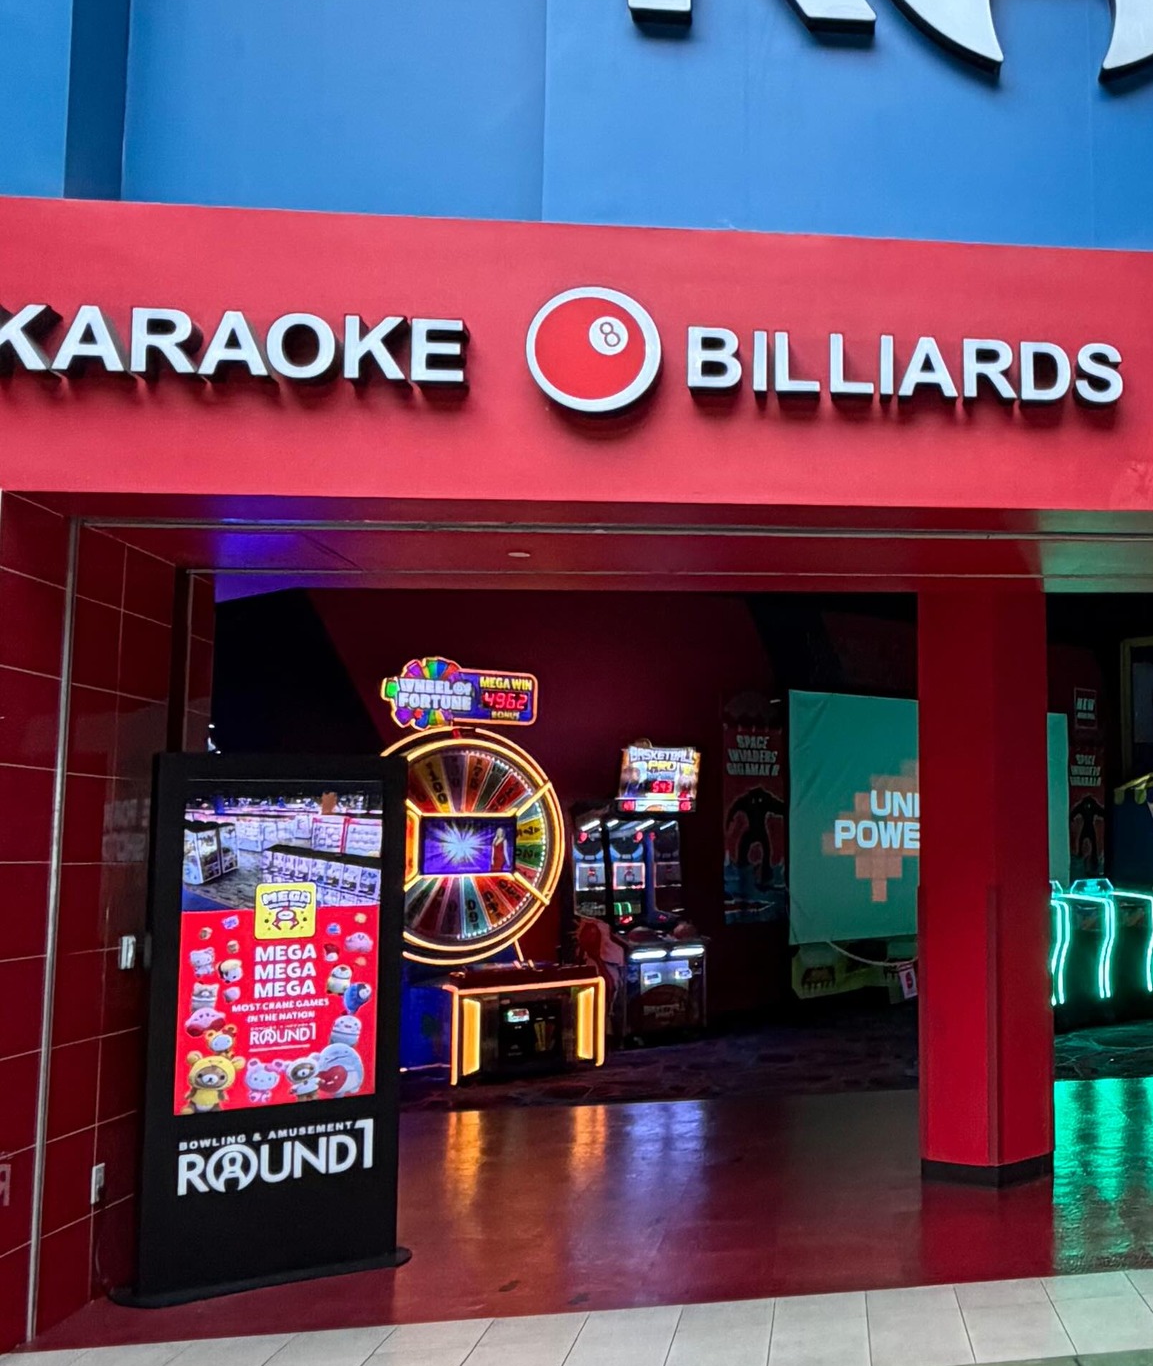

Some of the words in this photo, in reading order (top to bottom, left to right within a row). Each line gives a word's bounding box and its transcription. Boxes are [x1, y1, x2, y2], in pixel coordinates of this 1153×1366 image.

[599, 321, 621, 347] 8
[0, 303, 466, 384] KARAOKE
[686, 326, 1123, 404] BILLIARDS
[399, 678, 454, 695] WHEEL
[479, 676, 511, 689] MEGA
[511, 678, 533, 691] WIN
[398, 692, 473, 711] FORTUNE
[735, 734, 770, 749] SPACE
[629, 745, 695, 765] BASKETBALL
[727, 748, 779, 764] INVADERS
[261, 890, 312, 905] MEGA
[255, 943, 317, 962] MEGA
[254, 962, 317, 980] MEGA
[254, 980, 316, 998] MEGA
[231, 1002, 262, 1013] MOST
[262, 1001, 294, 1011] CRANE
[295, 998, 330, 1008] GAMES
[247, 1015, 259, 1023] IN
[260, 1014, 277, 1022] THE
[278, 1011, 316, 1021] NATION
[178, 1134, 247, 1151] BOWLING
[267, 1121, 353, 1140] AMUSEMENT
